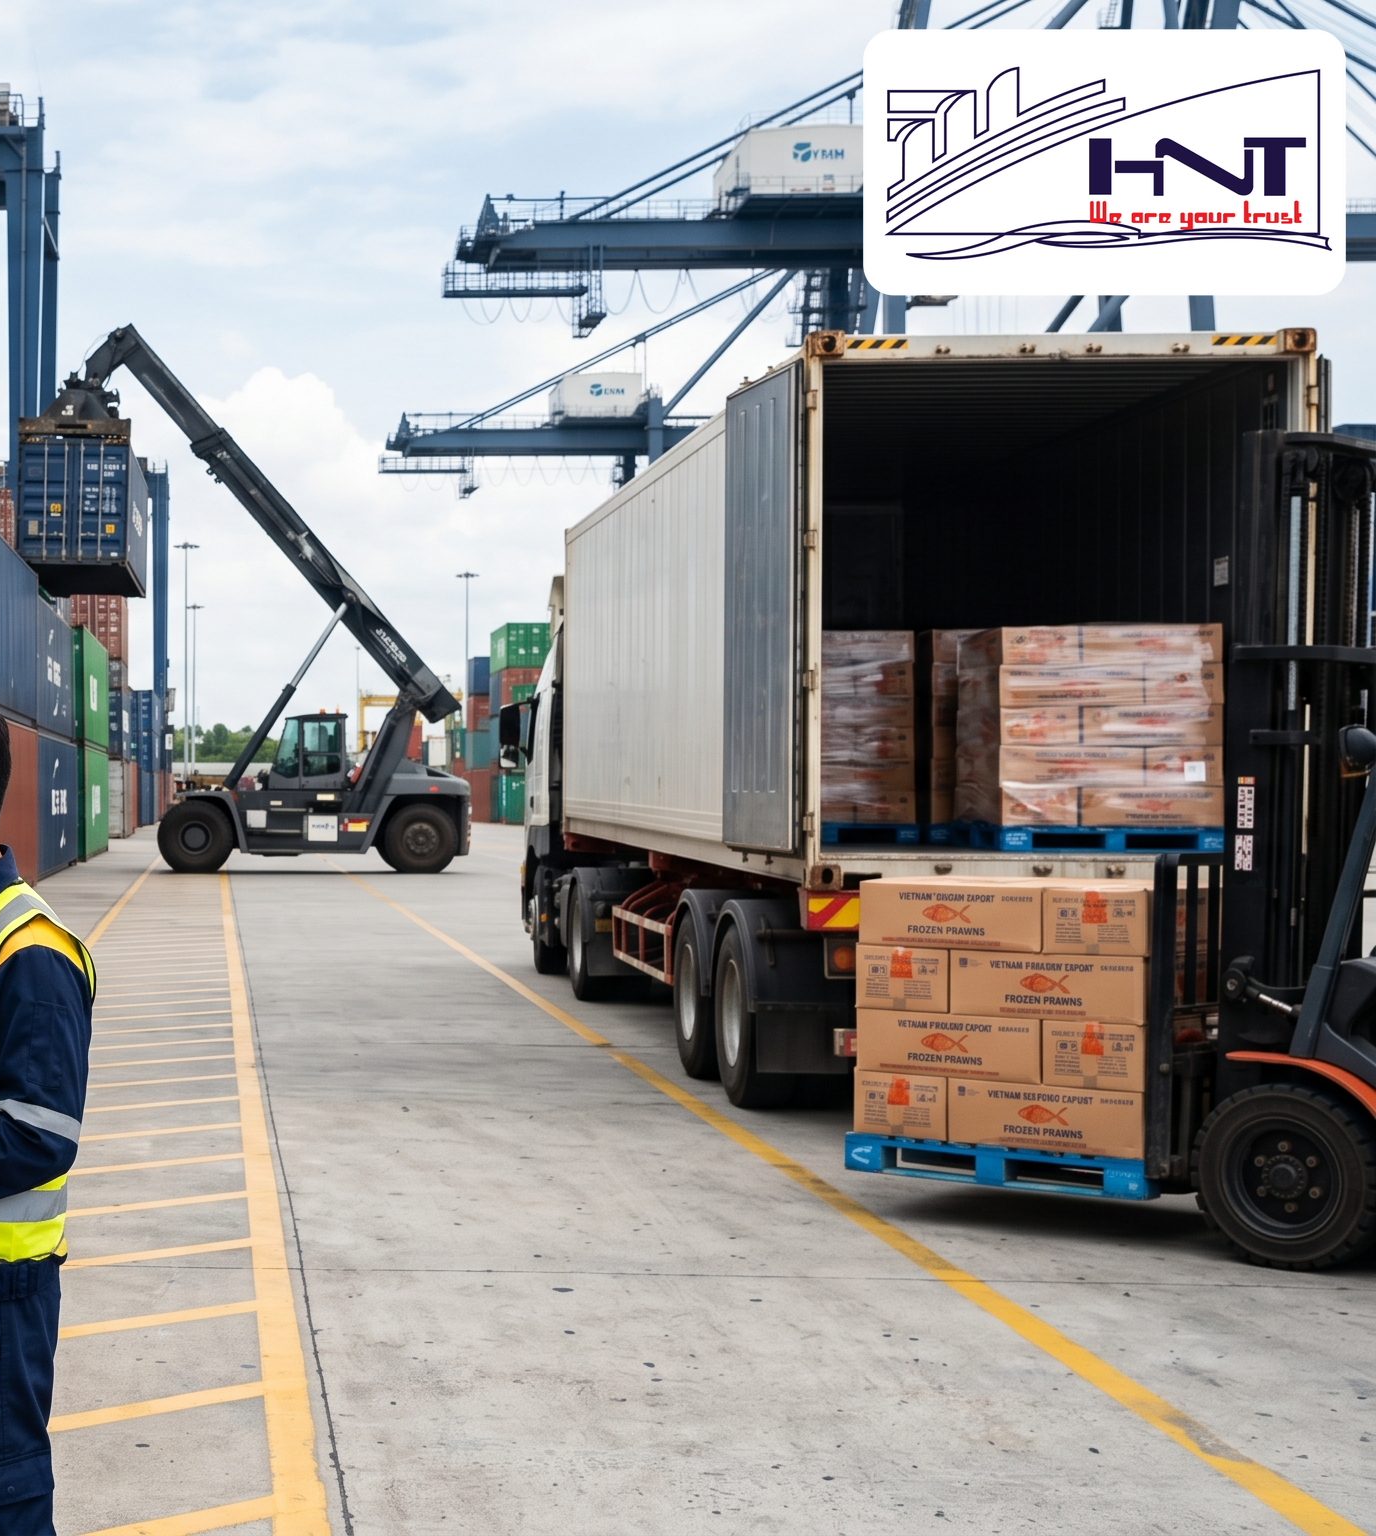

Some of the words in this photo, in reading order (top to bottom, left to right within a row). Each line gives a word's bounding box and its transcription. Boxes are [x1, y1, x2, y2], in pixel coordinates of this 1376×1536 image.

[907, 925, 943, 934] FROZEN
[946, 927, 985, 936] PRAWNS
[990, 960, 1023, 970] VIETNAM
[1005, 994, 1041, 1004] FROZEN
[1043, 996, 1082, 1006] PRAWNS
[907, 1052, 942, 1063] FROZEN
[945, 1055, 982, 1066] PRAWNS
[988, 1090, 1021, 1099] VIETNAM
[1003, 1124, 1040, 1136] FROZEN
[1043, 1128, 1083, 1139] PRAWNS
